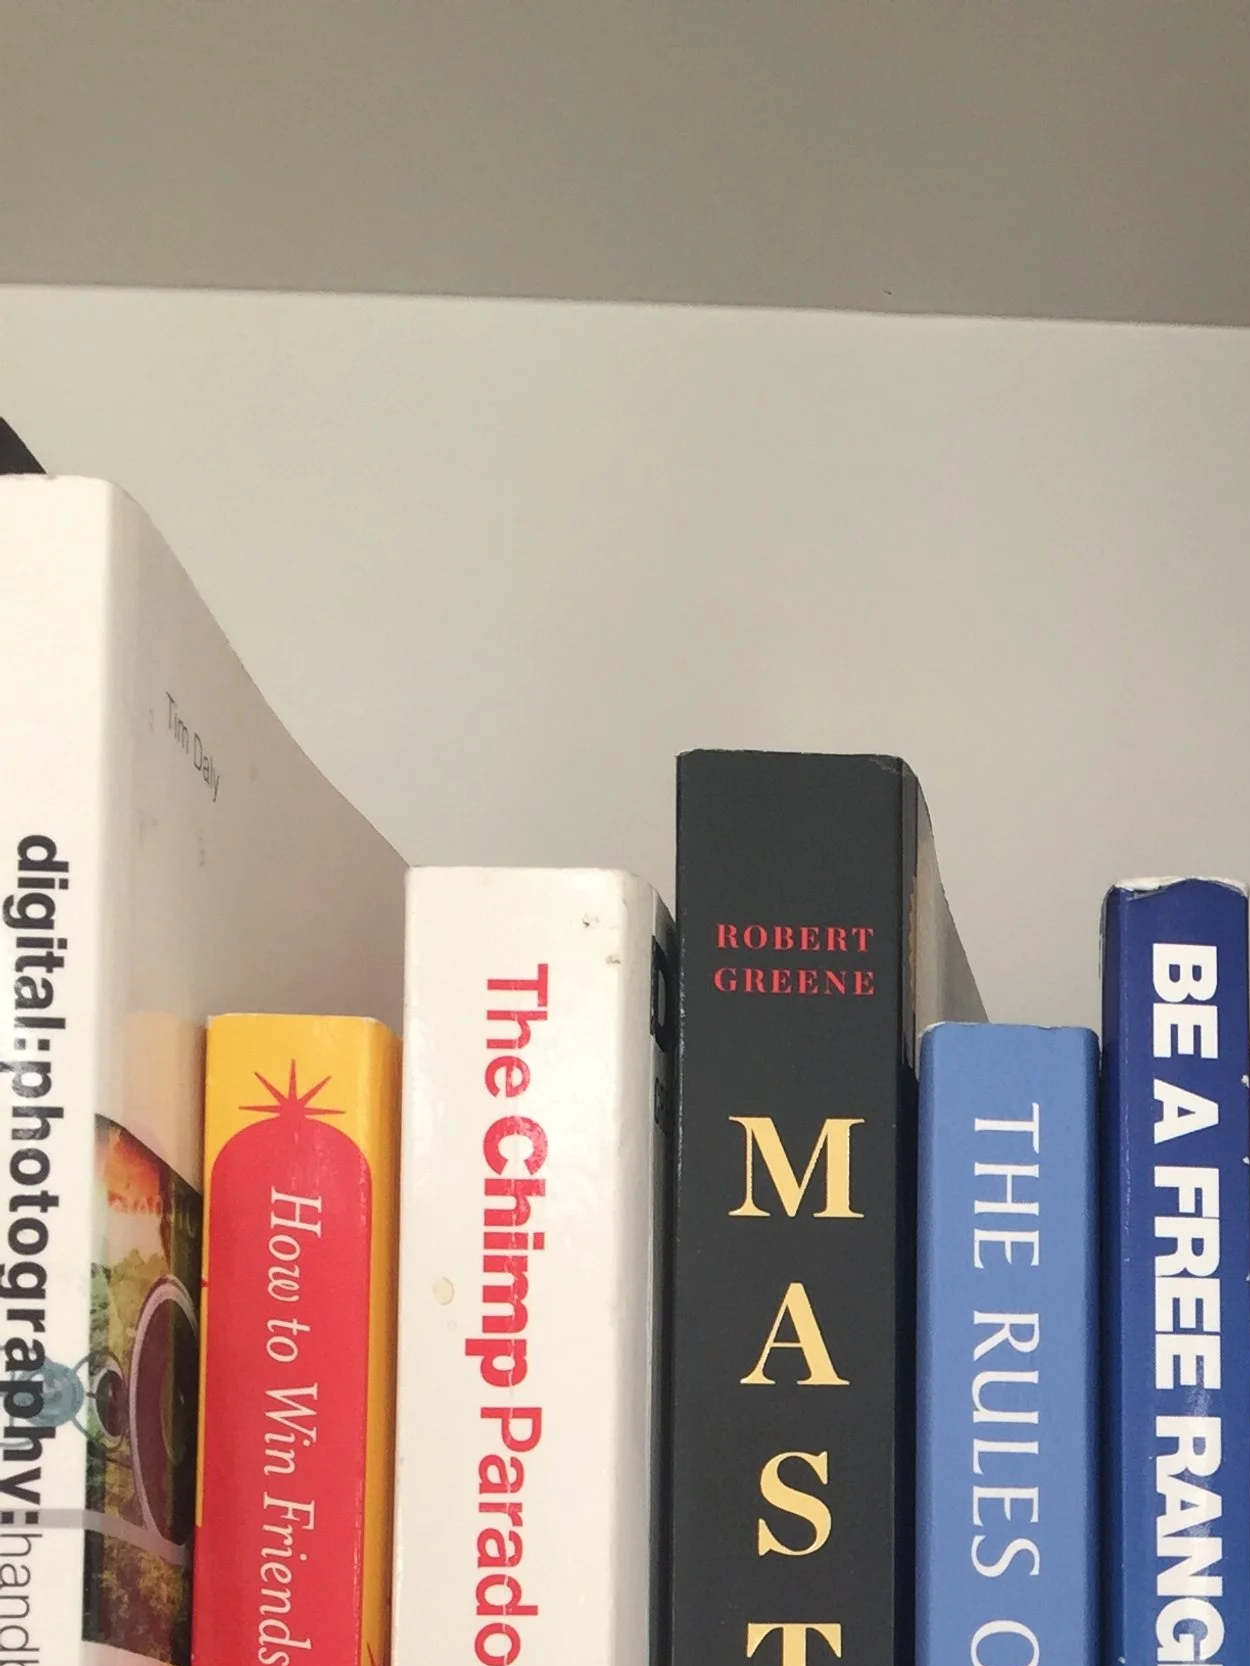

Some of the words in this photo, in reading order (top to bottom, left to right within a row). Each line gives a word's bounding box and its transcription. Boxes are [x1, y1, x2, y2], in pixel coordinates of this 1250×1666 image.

[166, 691, 189, 754] Tim
[193, 731, 220, 802] Daly
[714, 967, 875, 995] GREENE
[716, 923, 875, 952] ROBERT
[485, 962, 548, 1099] The
[1152, 942, 1219, 1061] BE
[1153, 1077, 1219, 1145] A
[974, 1102, 1040, 1269] THE
[269, 1186, 322, 1301] How
[464, 1116, 548, 1388] Chimp
[1154, 1166, 1222, 1390] FREE
[266, 1315, 310, 1364] to
[263, 1381, 318, 1476] Win
[970, 1310, 1041, 1580] RULES
